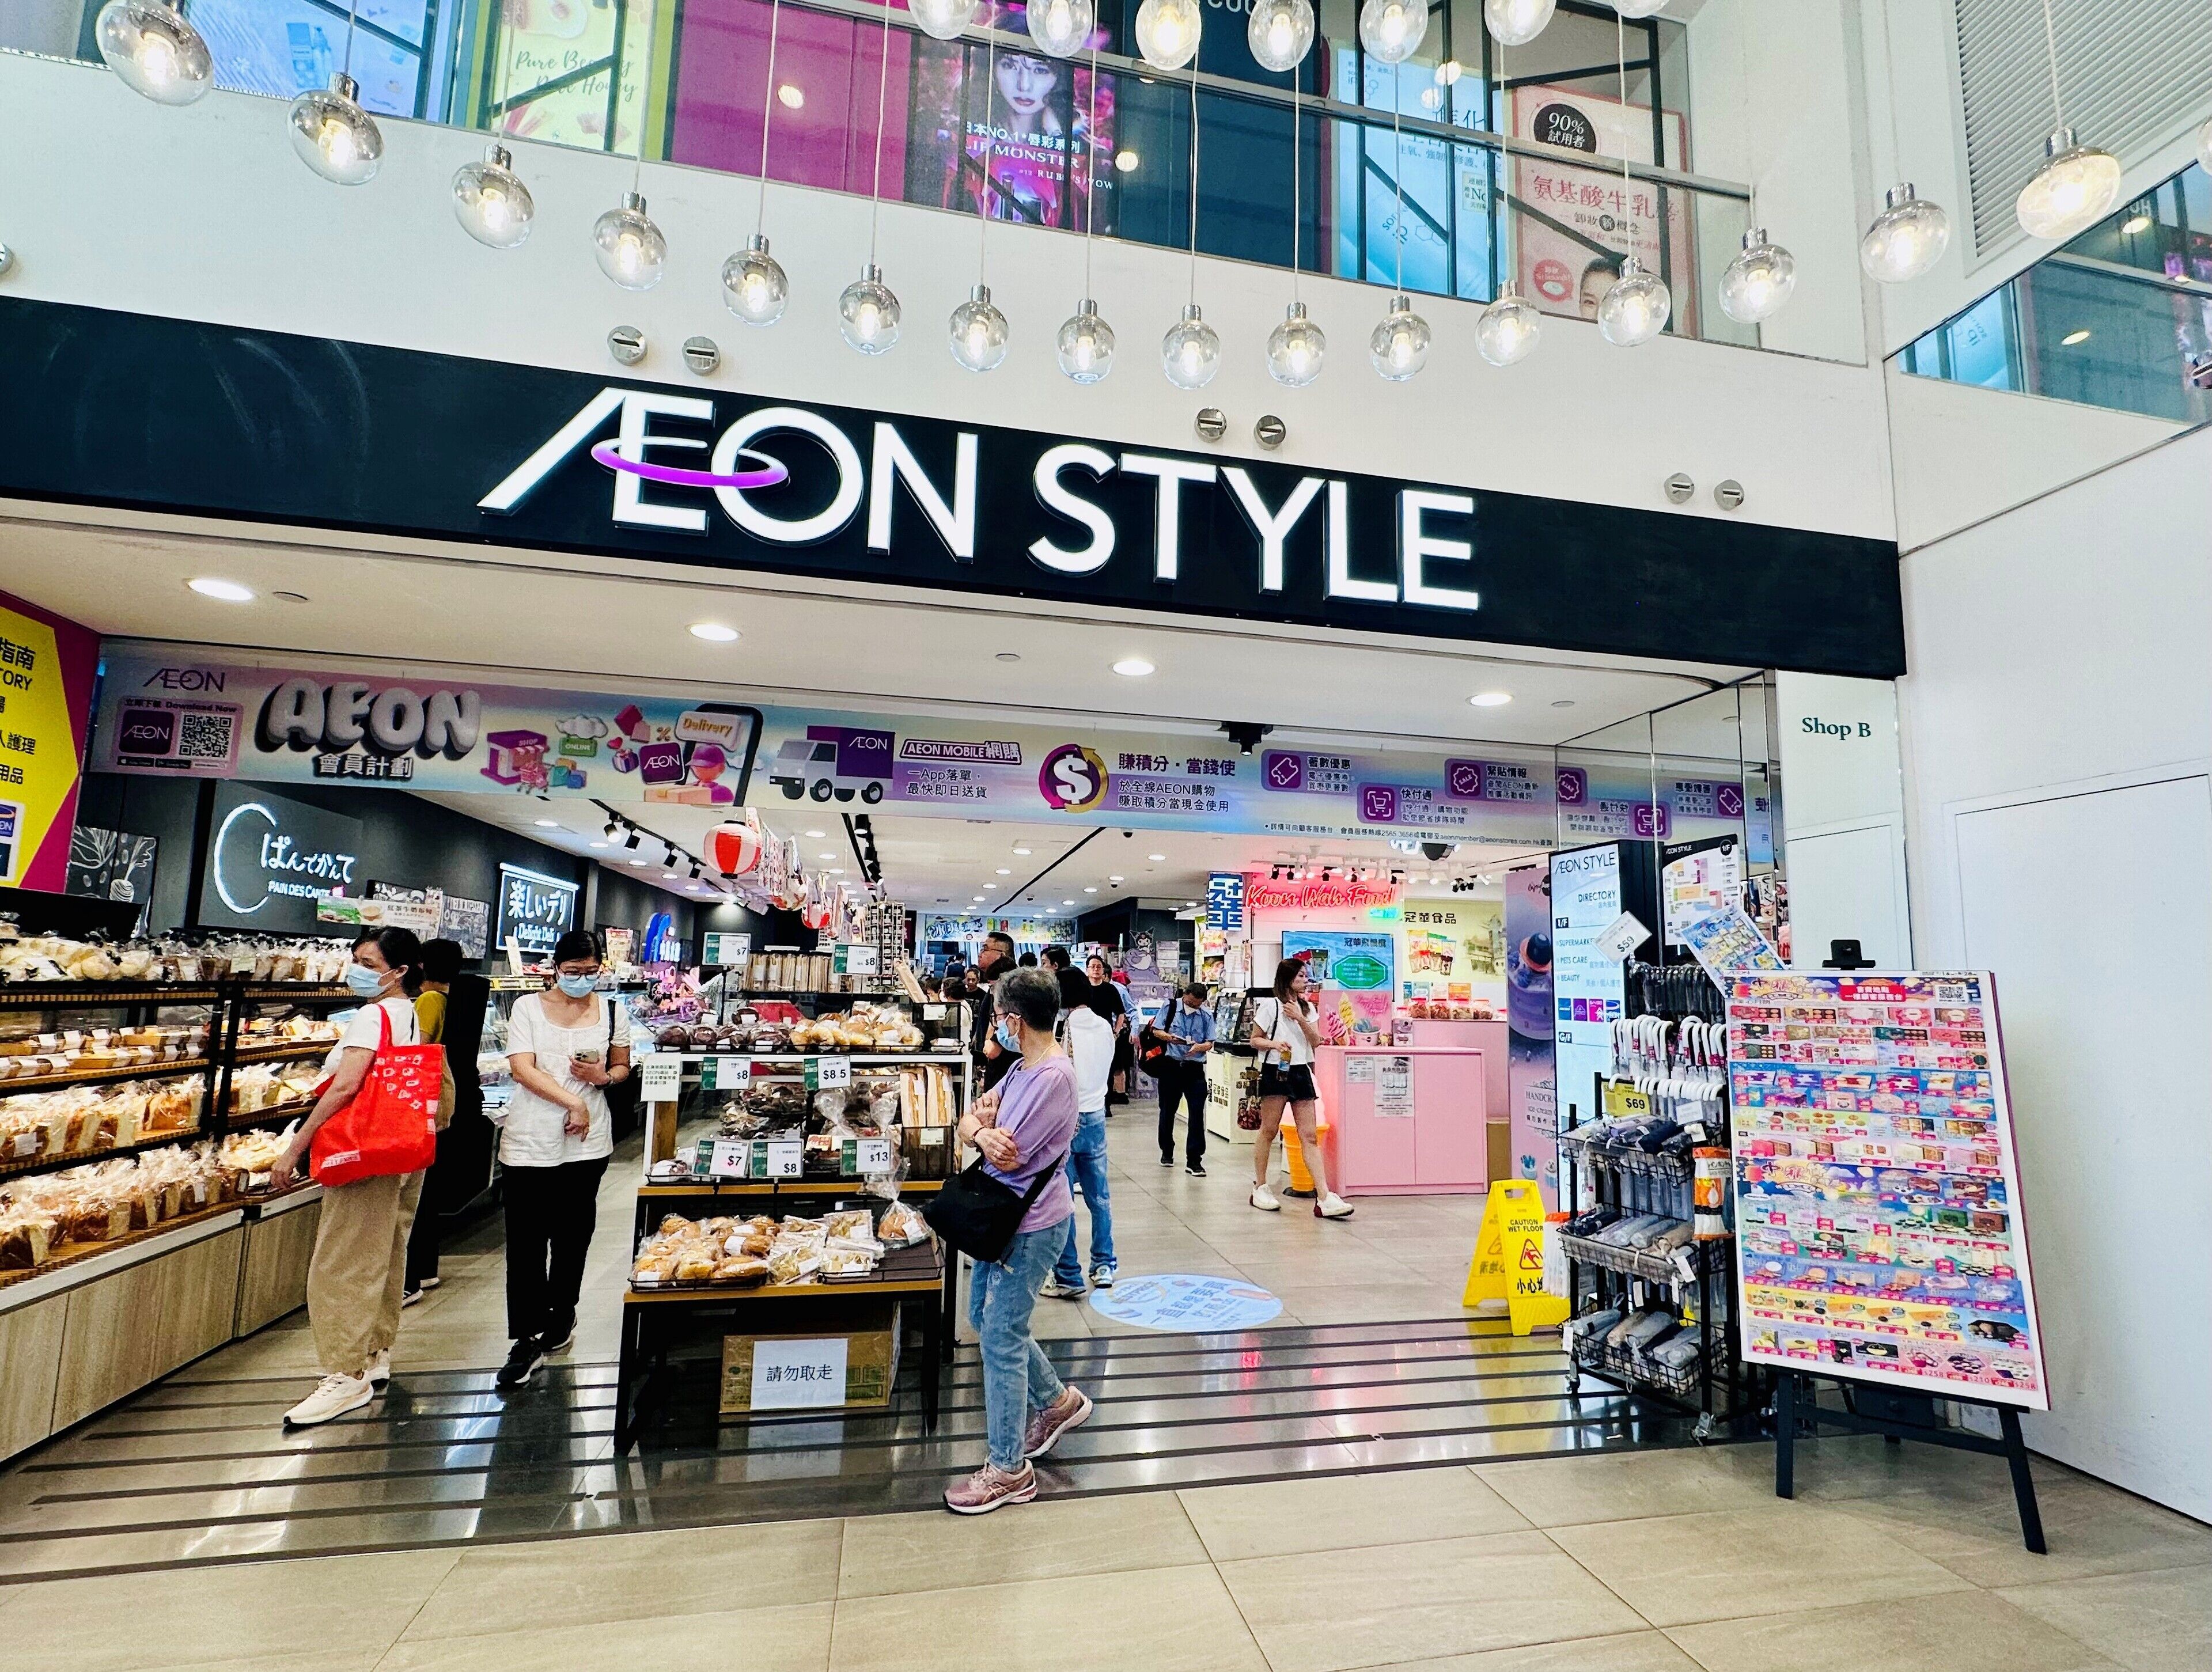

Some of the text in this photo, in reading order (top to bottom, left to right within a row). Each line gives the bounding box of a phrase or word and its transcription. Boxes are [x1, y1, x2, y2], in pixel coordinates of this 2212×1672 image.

[515, 50, 556, 70] Pure
[1547, 111, 1585, 137] 90%
[1028, 442, 1480, 614] STYLE
[165, 700, 213, 711] Download
[215, 704, 237, 713] Now
[683, 717, 733, 738] Delivery
[1802, 716, 1872, 741] Shop B
[907, 742, 940, 755] AEON
[317, 753, 412, 779] 會員計劃
[907, 782, 988, 799] 最快即日送貨
[1401, 788, 1433, 801] 快付通
[1583, 851, 1616, 870] STYLE
[1346, 882, 1395, 908] Food
[1578, 890, 1616, 903] DIRECTORY
[1617, 935, 1635, 953] $59
[737, 947, 747, 956] $7
[865, 958, 876, 966] $8
[1560, 974, 1581, 982] BEAUTY
[737, 1070, 748, 1079] $8
[1625, 1097, 1645, 1109] $69
[727, 1155, 742, 1167] $7
[869, 1151, 888, 1163] $13
[783, 1163, 797, 1175] $8
[766, 1364, 833, 1382] 請勿取走
